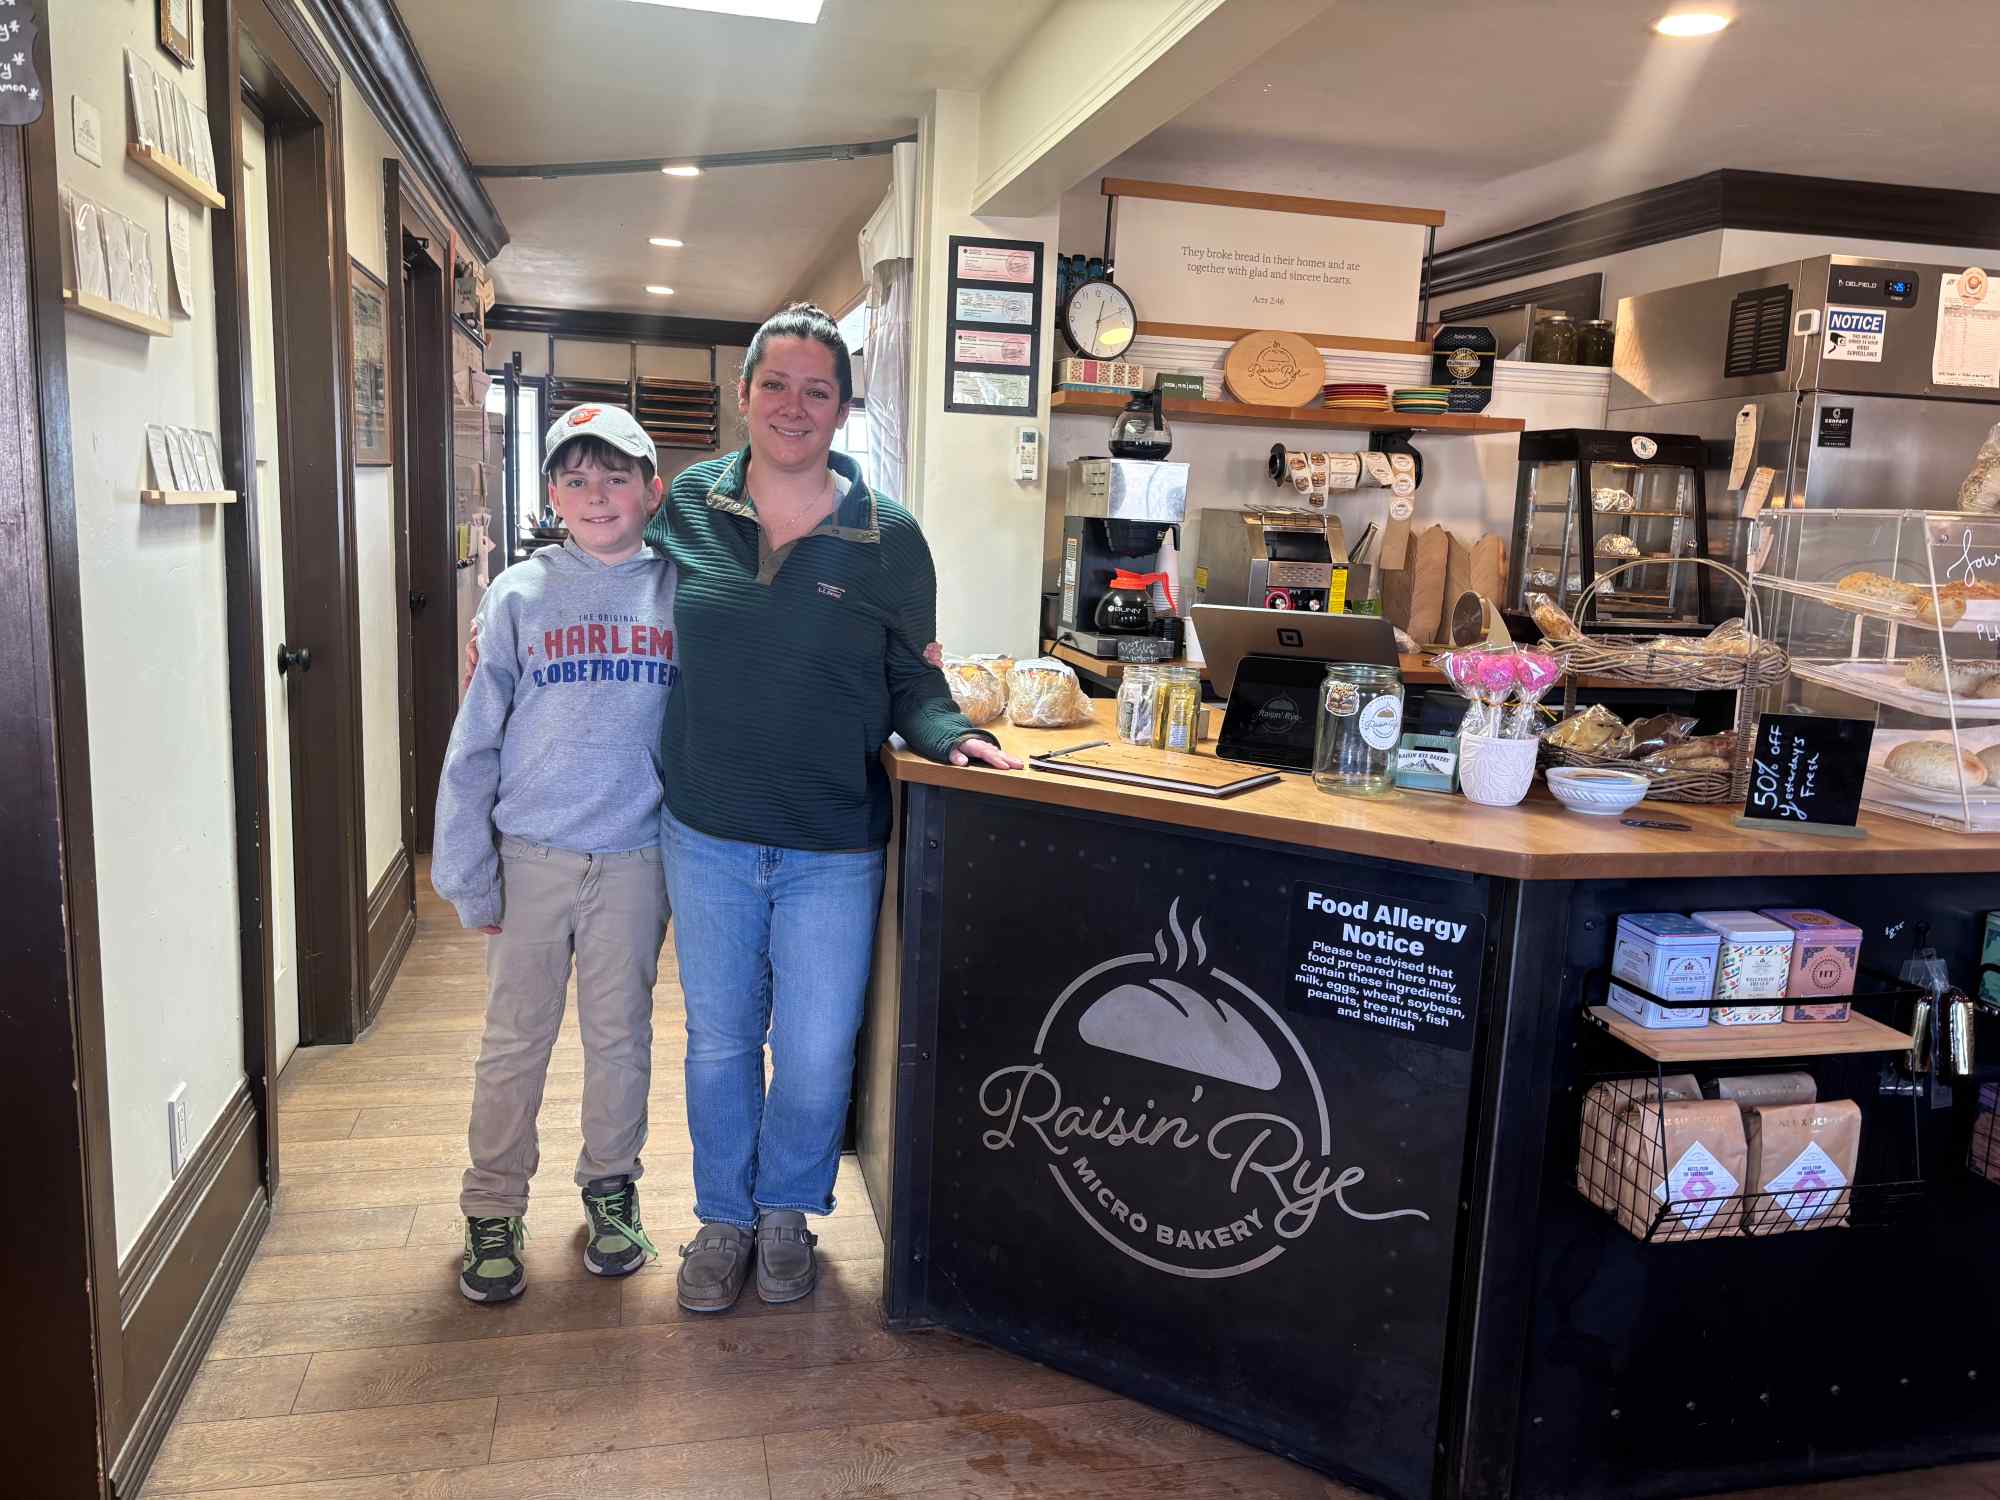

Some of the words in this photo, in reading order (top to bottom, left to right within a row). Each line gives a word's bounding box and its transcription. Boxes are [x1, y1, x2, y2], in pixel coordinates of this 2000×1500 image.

[1181, 246, 1205, 260] They
[1207, 248, 1233, 260] broke
[1235, 250, 1260, 263] bread
[1262, 254, 1271, 264] in
[1273, 254, 1295, 266] their
[1297, 257, 1326, 268] homes
[1328, 259, 1344, 270] and
[1346, 262, 1360, 270] ate
[1187, 262, 1225, 275] together
[1227, 264, 1247, 276] with
[1249, 266, 1268, 279] glad
[1270, 269, 1287, 280] and
[1289, 270, 1321, 283] sincere
[1322, 273, 1352, 285] hearts.
[1252, 295, 1268, 305] Acts
[1830, 313, 1882, 331] NOTICE
[578, 614, 594, 623] THE
[598, 613, 640, 623] ORIGINAL
[544, 623, 674, 662] HARLEM
[1753, 758, 1781, 811] 50%
[1307, 891, 1368, 921] Food
[1373, 904, 1468, 944] Allergy
[1342, 922, 1425, 957] Notice
[1307, 951, 1335, 966] food
[1337, 959, 1394, 978] prepared
[1398, 970, 1426, 985] here
[1429, 979, 1457, 993] may
[1312, 940, 1353, 958] Please
[1356, 949, 1372, 962] be
[1374, 955, 1425, 973] advised
[1427, 964, 1454, 979] that
[1295, 973, 1324, 987] milk,
[1326, 980, 1360, 995] eggs,
[1363, 987, 1404, 1005] wheat,
[1407, 997, 1466, 1020] soybean,
[1300, 962, 1345, 980] contain
[1348, 971, 1383, 988] these
[1385, 979, 1462, 1005] ingredients:
[1307, 988, 1361, 1008] peanuts,
[1363, 999, 1388, 1013] tree
[1391, 1005, 1423, 1023] nuts,
[1425, 1012, 1450, 1027] fish
[1337, 1006, 1361, 1019] and
[1363, 1010, 1416, 1032] shellfish
[979, 1062, 1204, 1156] Raisin'
[1207, 1111, 1430, 1239] Rye
[1072, 1156, 1148, 1233] MICRO
[1156, 1207, 1265, 1250] BAKERY
